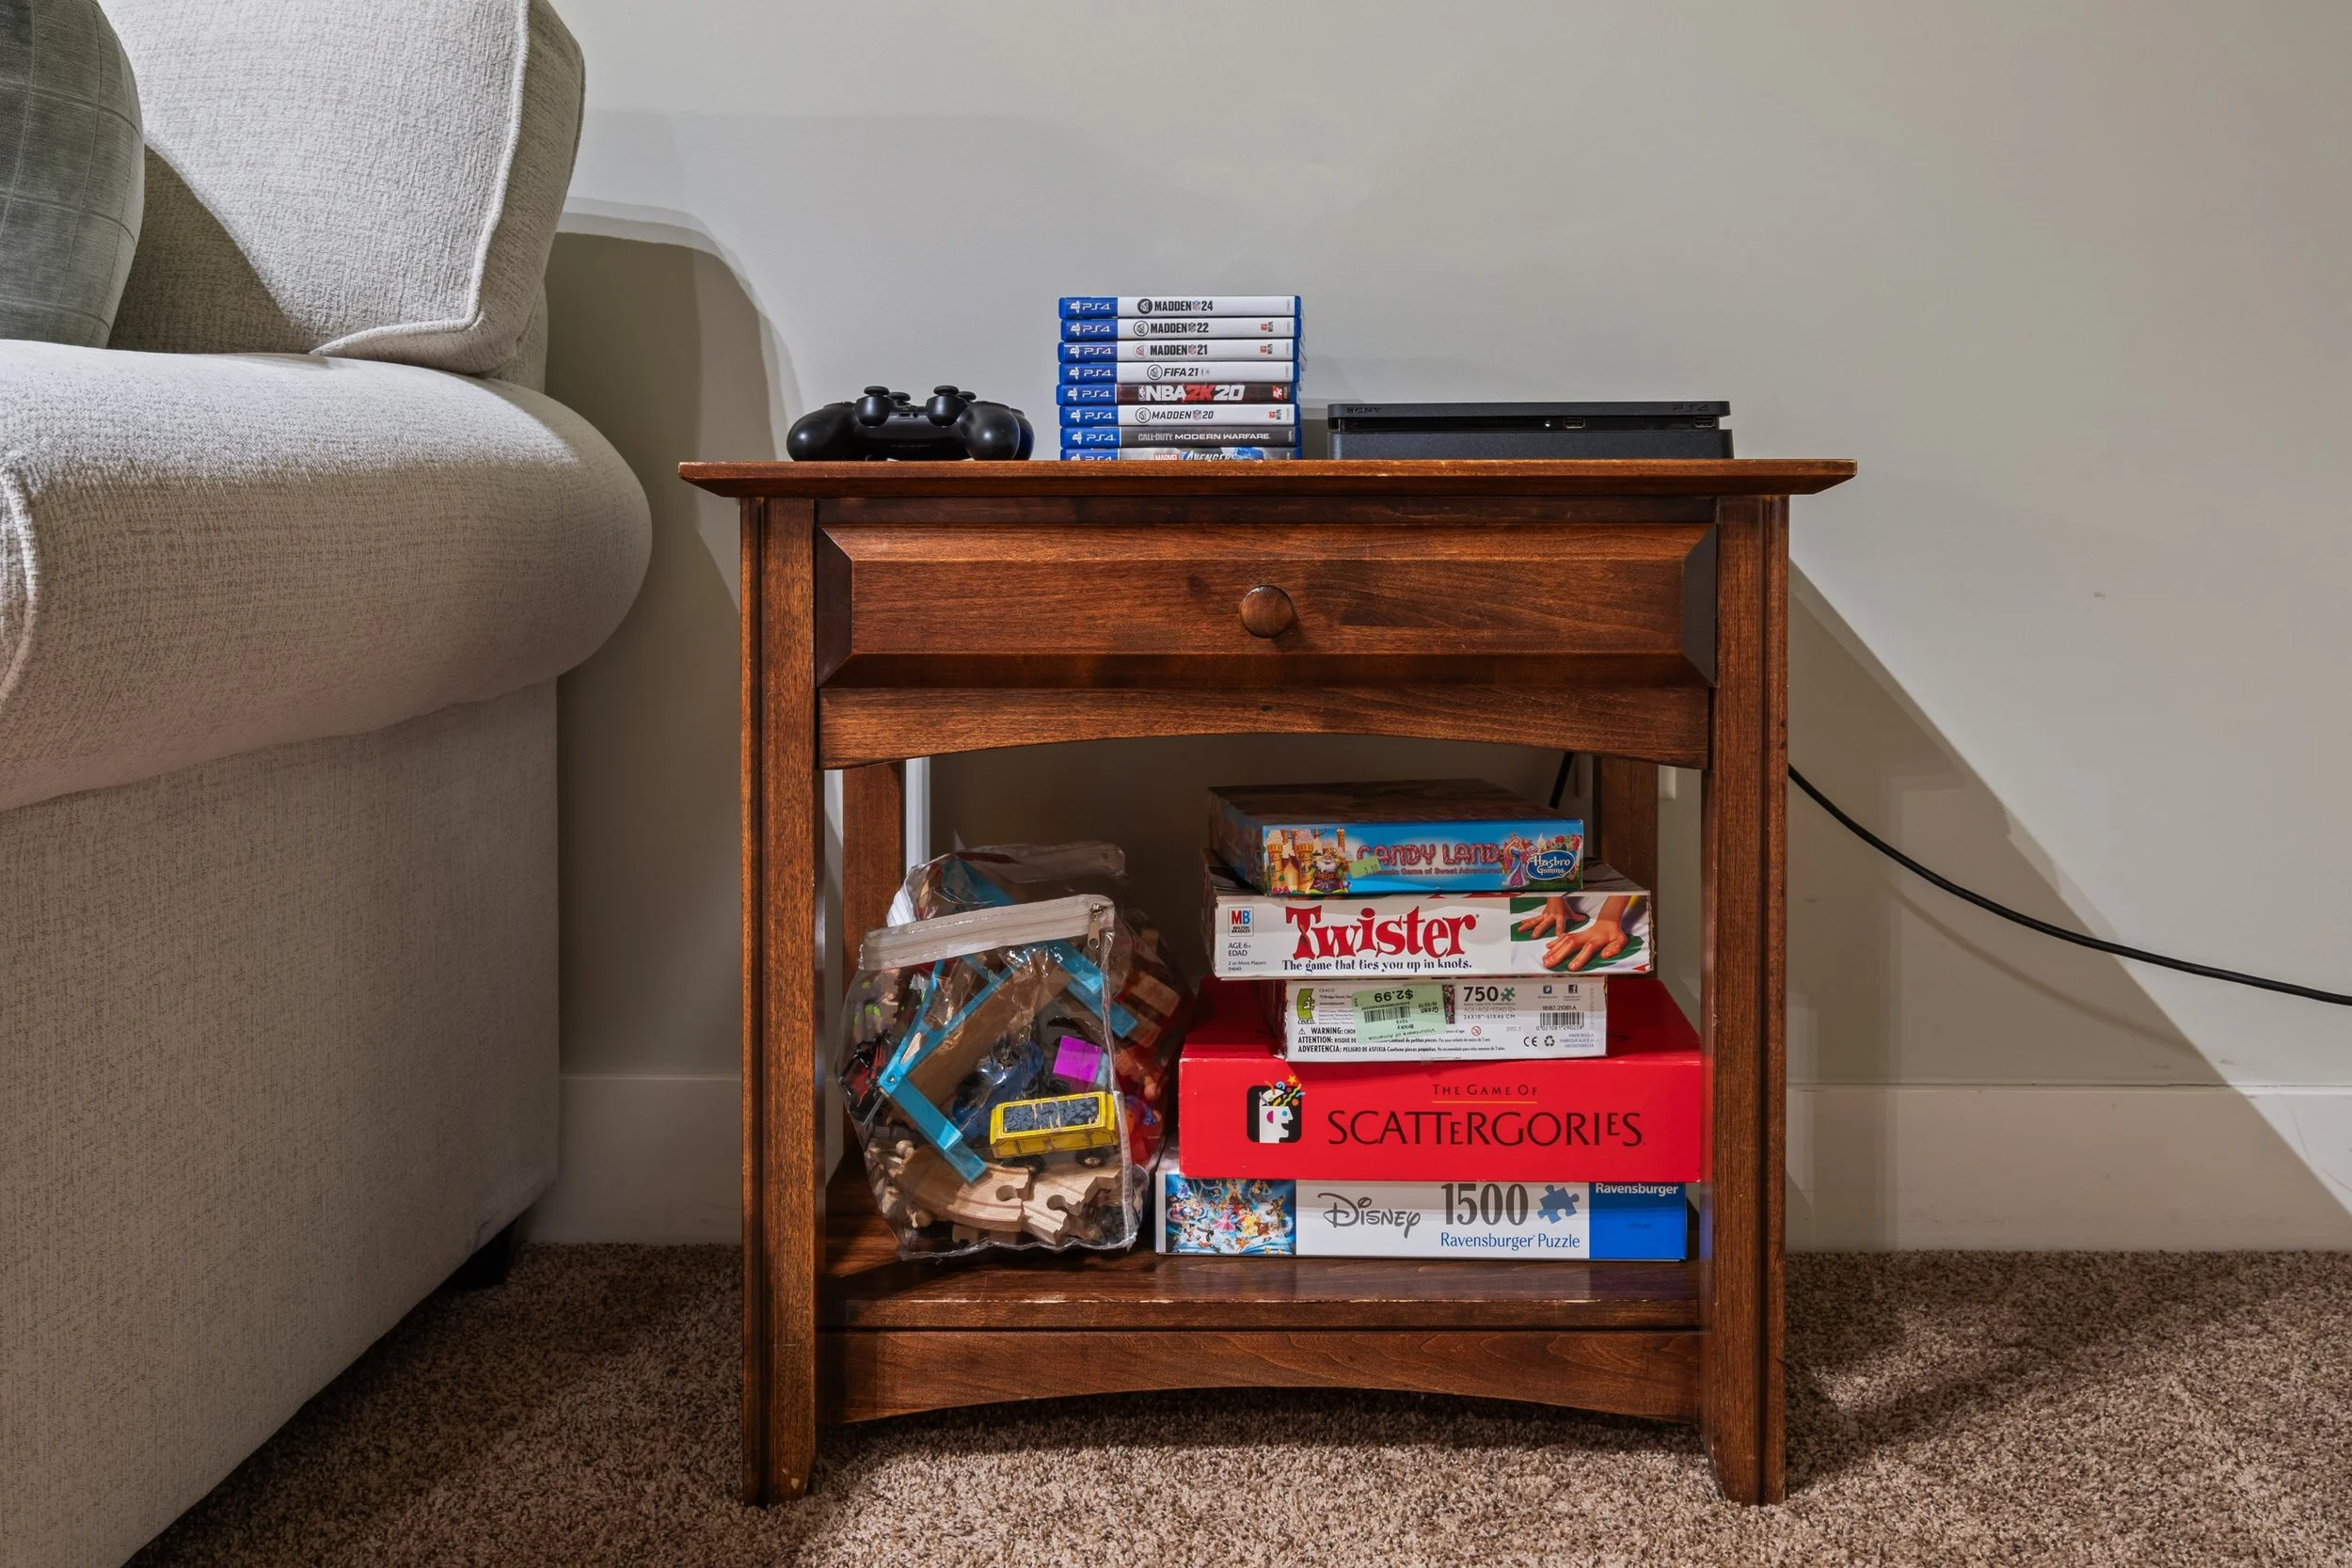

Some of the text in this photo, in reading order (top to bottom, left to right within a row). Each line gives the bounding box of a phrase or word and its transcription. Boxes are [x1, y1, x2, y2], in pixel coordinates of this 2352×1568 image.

[1154, 301, 1192, 311] MADDEN
[1201, 301, 1214, 311] 24
[1151, 323, 1187, 334] MADDEN
[1197, 323, 1209, 333] 22
[1150, 345, 1187, 356] MADDEN
[1197, 344, 1208, 355] 21
[1164, 368, 1186, 376] FIFA
[1188, 368, 1199, 376] 21
[1152, 411, 1191, 420] MADDEN
[1202, 411, 1214, 420] 20
[1357, 843, 1501, 865] CANDY LAND
[1529, 854, 1570, 868] Hasbro
[1536, 866, 1565, 875] Gaming
[1232, 911, 1250, 925] MB
[1285, 905, 1477, 960] Twister
[1281, 958, 1472, 975] The game that ties you up in knots.
[1375, 990, 1414, 1003] $2.99
[1463, 986, 1499, 1002] 750
[1327, 1110, 1643, 1147] SCATTERGORIES
[1596, 1182, 1678, 1196] Ravensburger
[1440, 1182, 1529, 1226] 1500
[1440, 1232, 1581, 1251] Ravensburger Puzzle
